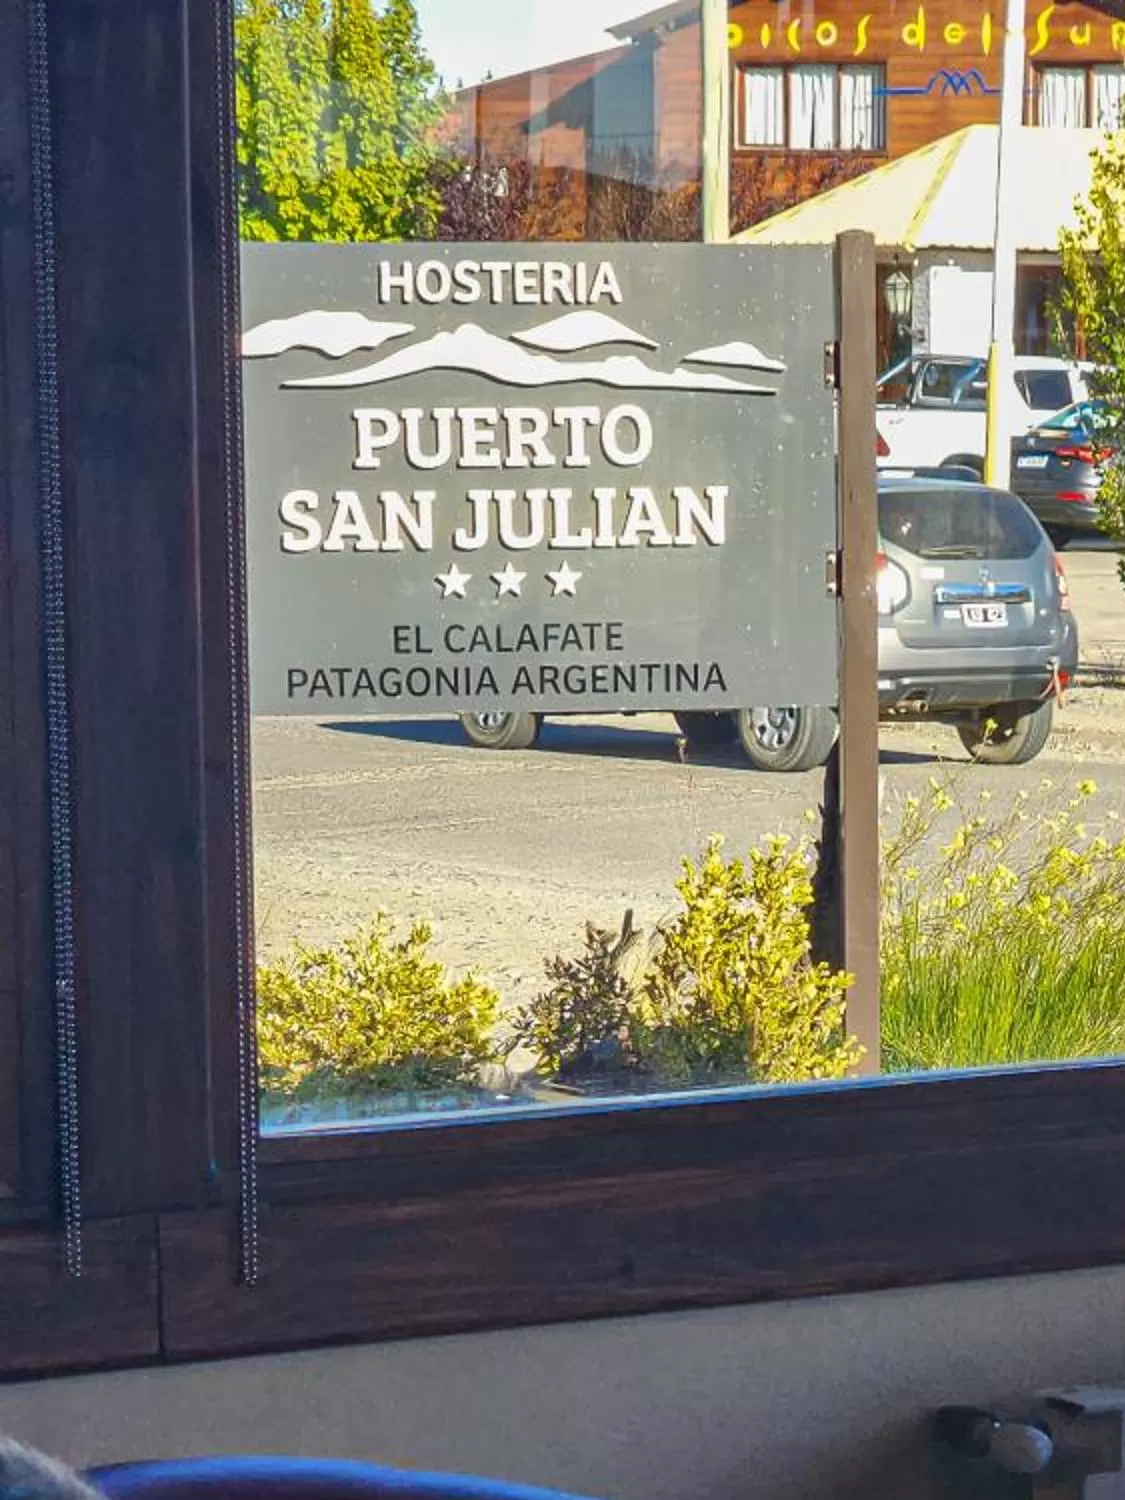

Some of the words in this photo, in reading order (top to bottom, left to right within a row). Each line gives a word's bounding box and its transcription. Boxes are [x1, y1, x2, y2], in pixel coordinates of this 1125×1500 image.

[902, 4, 991, 56] del
[379, 260, 623, 304] HOSTERIA
[352, 404, 653, 470] PUERTO
[279, 489, 436, 552] SAN
[453, 485, 729, 549] JULIAN
[393, 625, 432, 654] EL
[444, 621, 624, 653] CALAFATE
[287, 666, 499, 697] PATAGONIA
[511, 662, 728, 694] ARGENTINA
